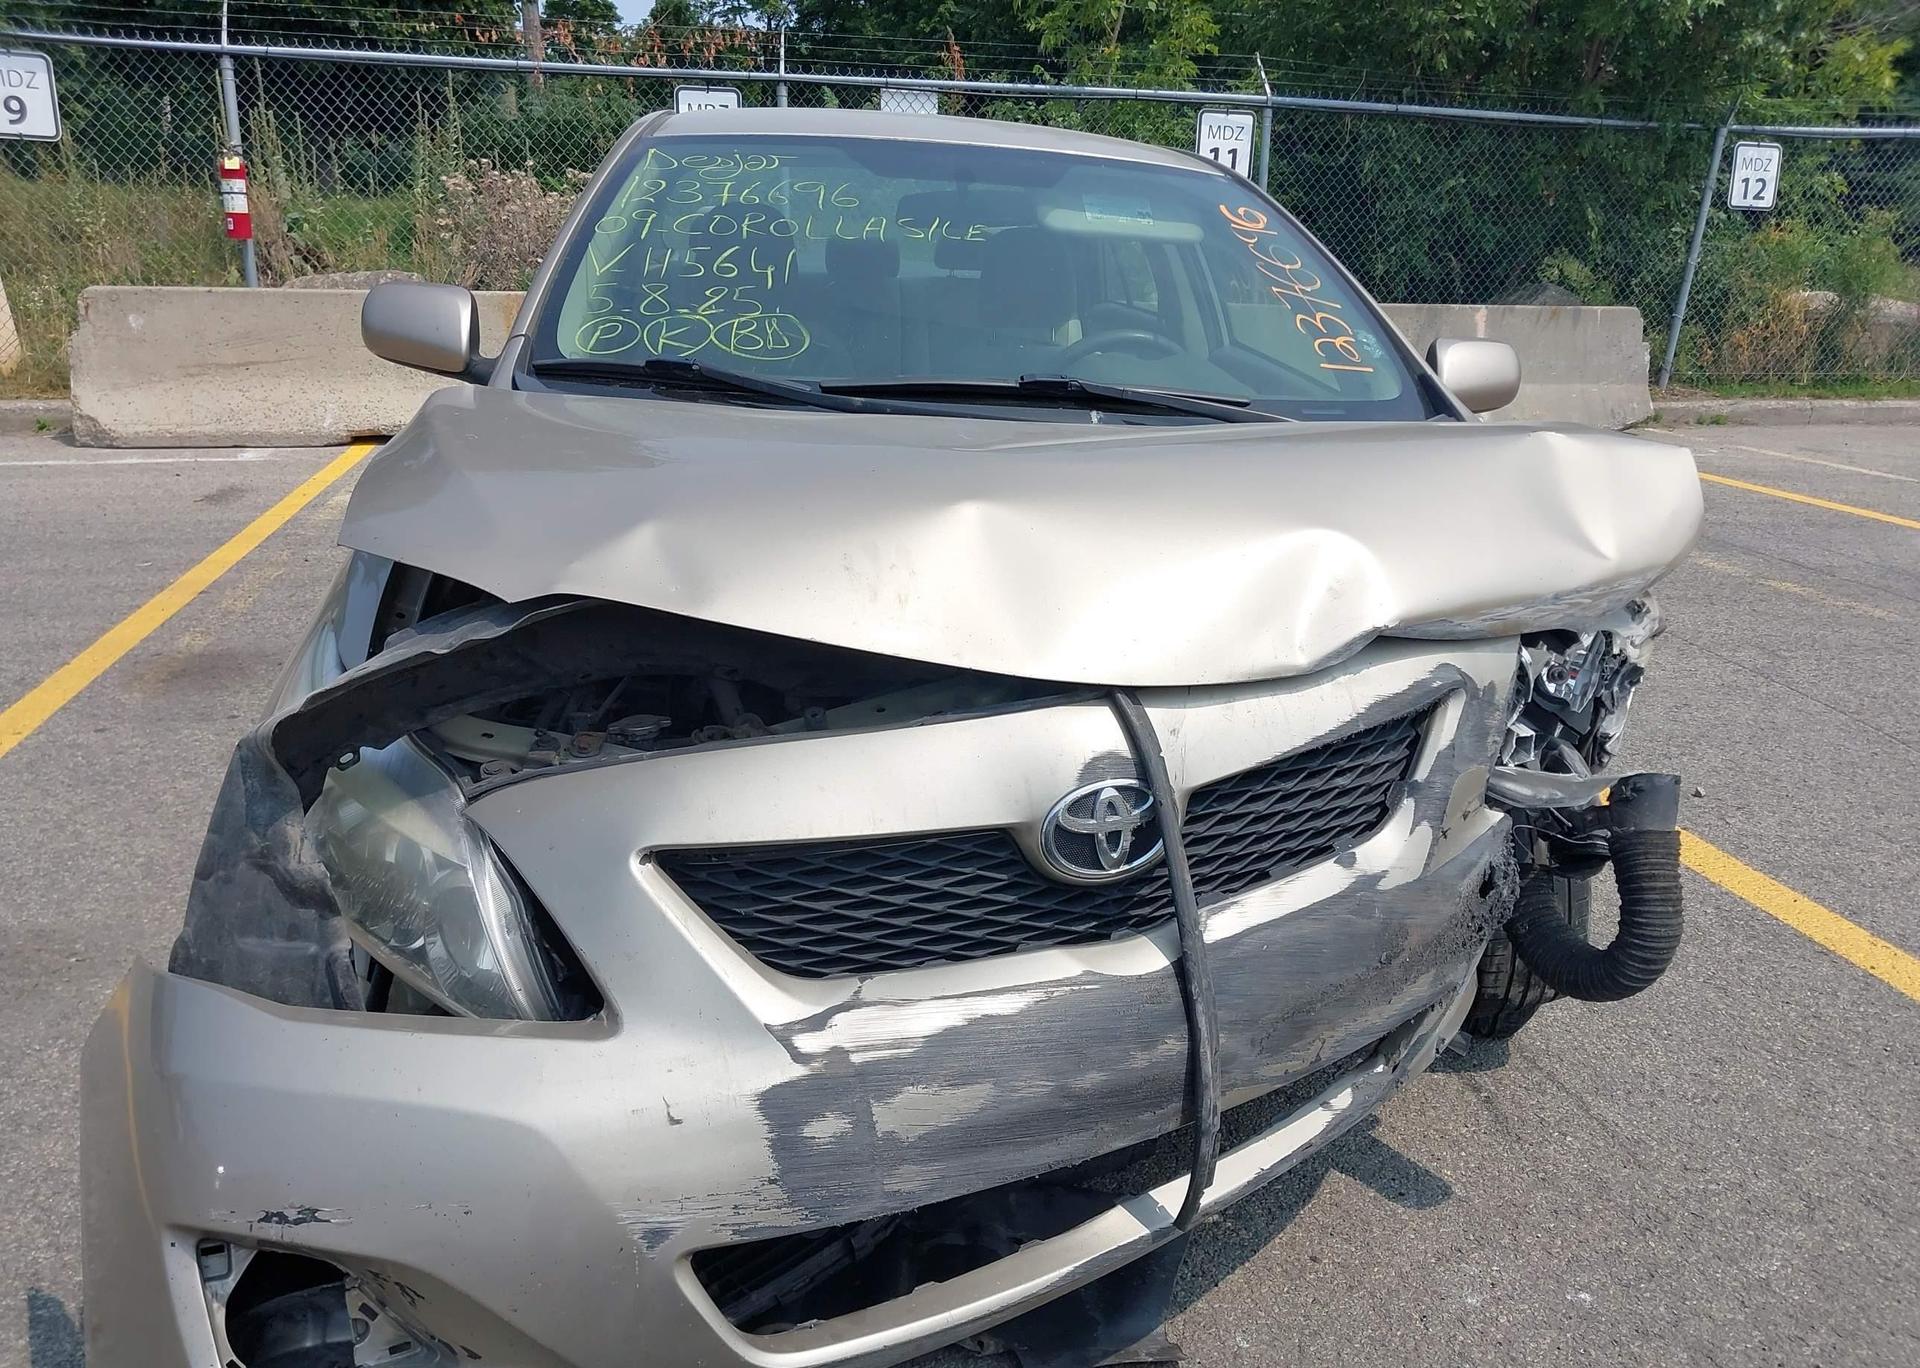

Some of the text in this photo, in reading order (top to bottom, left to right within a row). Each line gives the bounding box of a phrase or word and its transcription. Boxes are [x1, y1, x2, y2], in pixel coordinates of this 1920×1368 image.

[3, 95, 28, 125] 9
[1207, 125, 1245, 141] MDZ
[1741, 157, 1773, 172] MDZ
[621, 176, 859, 211] 12376696
[1741, 177, 1767, 200] 12
